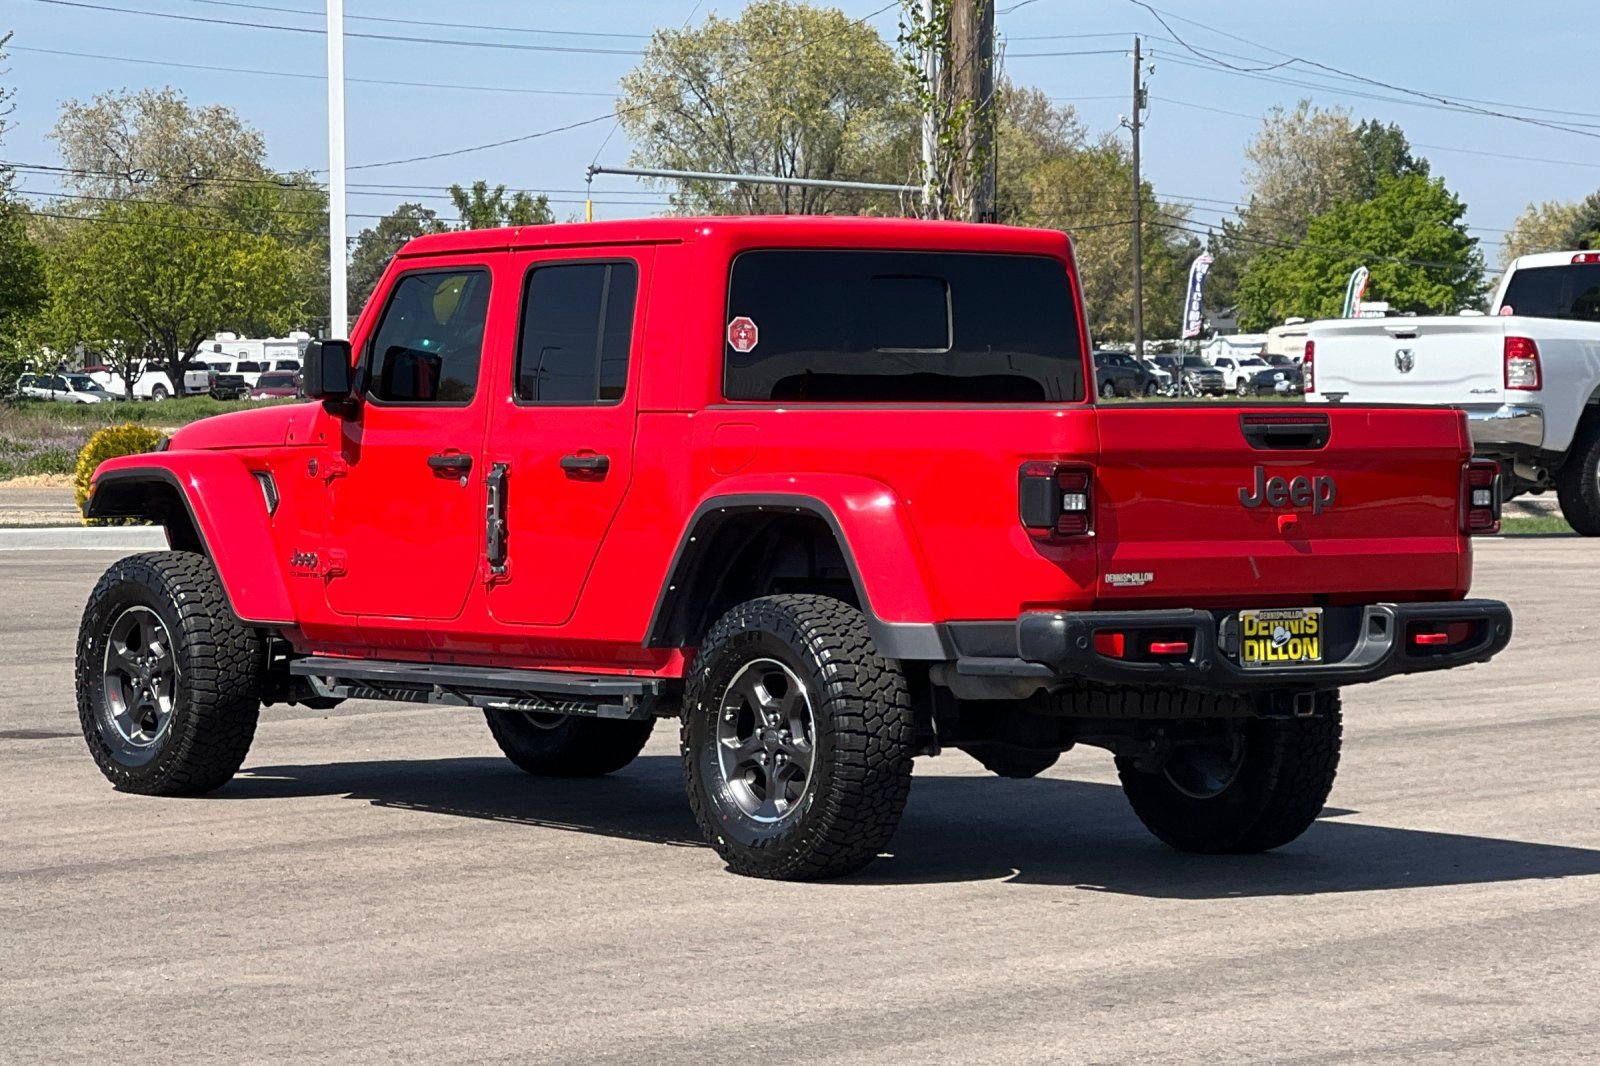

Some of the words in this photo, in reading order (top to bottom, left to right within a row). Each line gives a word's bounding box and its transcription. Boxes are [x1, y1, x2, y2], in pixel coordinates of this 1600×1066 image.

[1188, 262, 1209, 331] WELCOME
[1237, 465, 1336, 516] Jeep
[290, 547, 318, 571] Jeep
[1104, 573, 1128, 583] DENNIS
[1131, 572, 1154, 582] DILLON
[1244, 613, 1318, 636] DENNIS
[1244, 637, 1318, 662] DILLON
